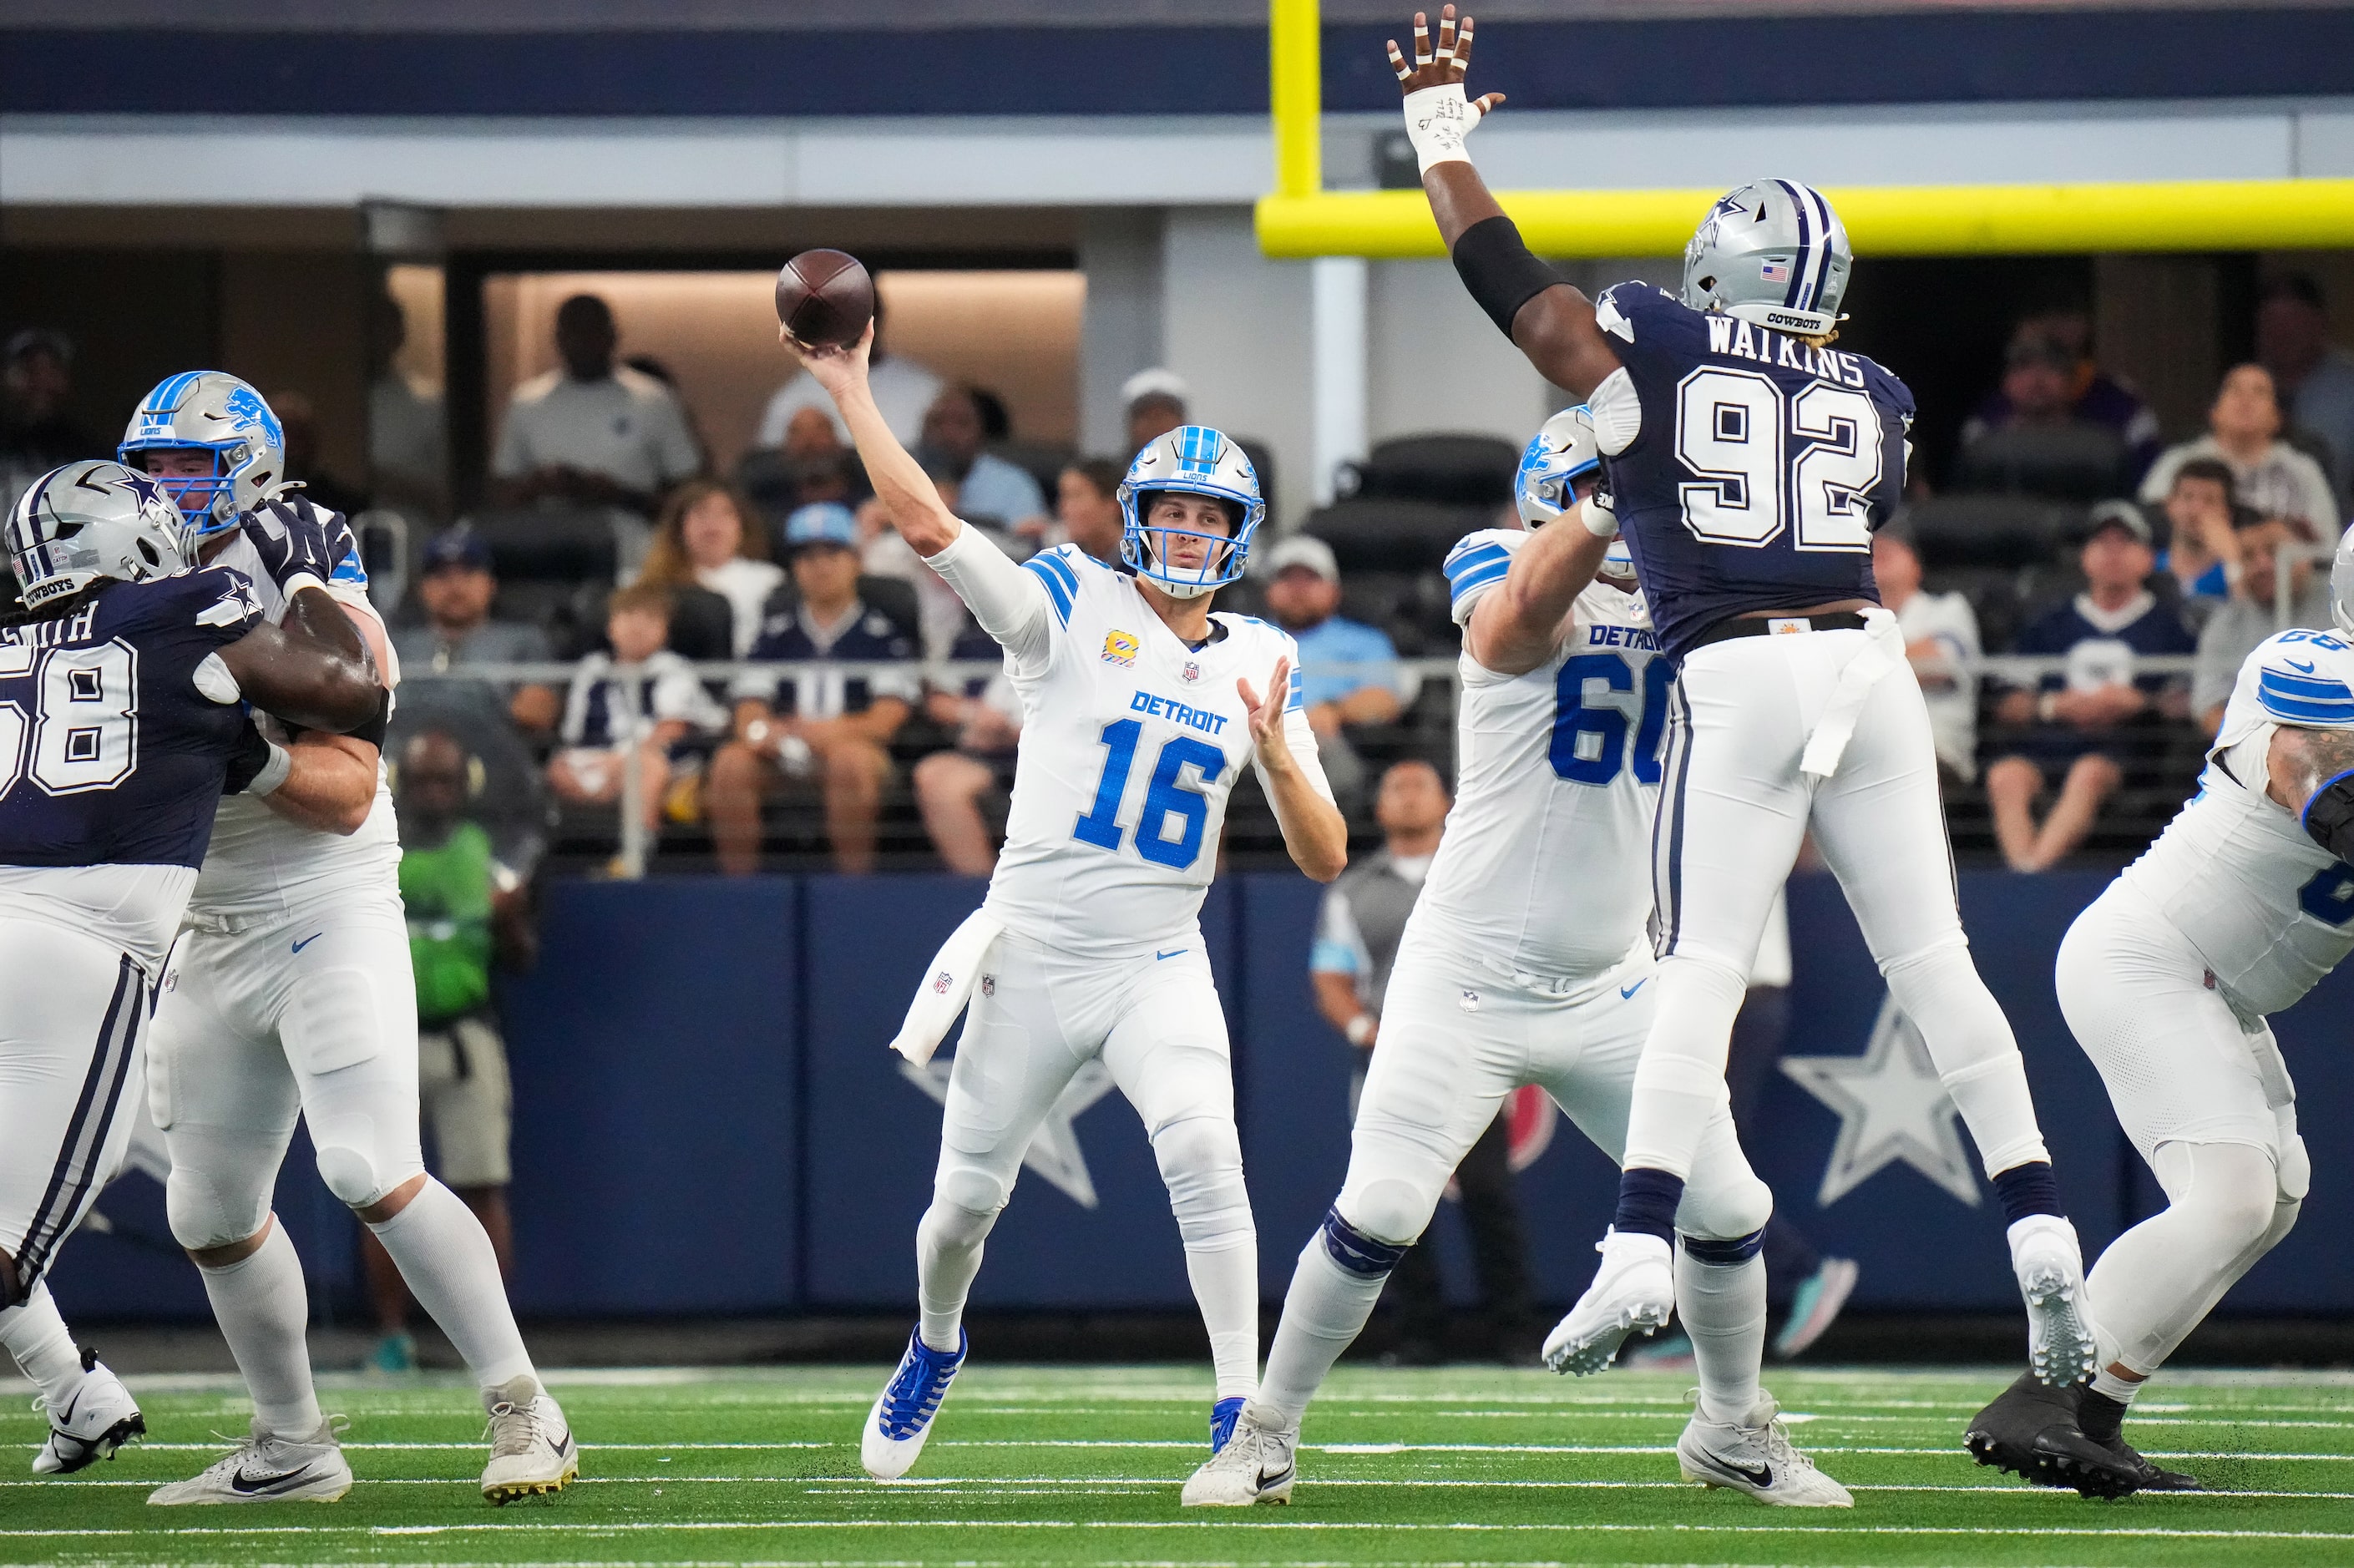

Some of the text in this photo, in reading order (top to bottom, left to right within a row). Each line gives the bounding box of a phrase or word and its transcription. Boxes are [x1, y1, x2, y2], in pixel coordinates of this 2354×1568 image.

[1767, 313, 1821, 330] COWBOYS
[1704, 316, 1865, 387] WATKINS
[1183, 472, 1208, 482] LIONS
[1675, 364, 1884, 554] 92
[2, 599, 99, 649] SMITH
[1106, 630, 1140, 659] C
[1130, 690, 1228, 735] DETROIT
[1070, 715, 1228, 873] 16
